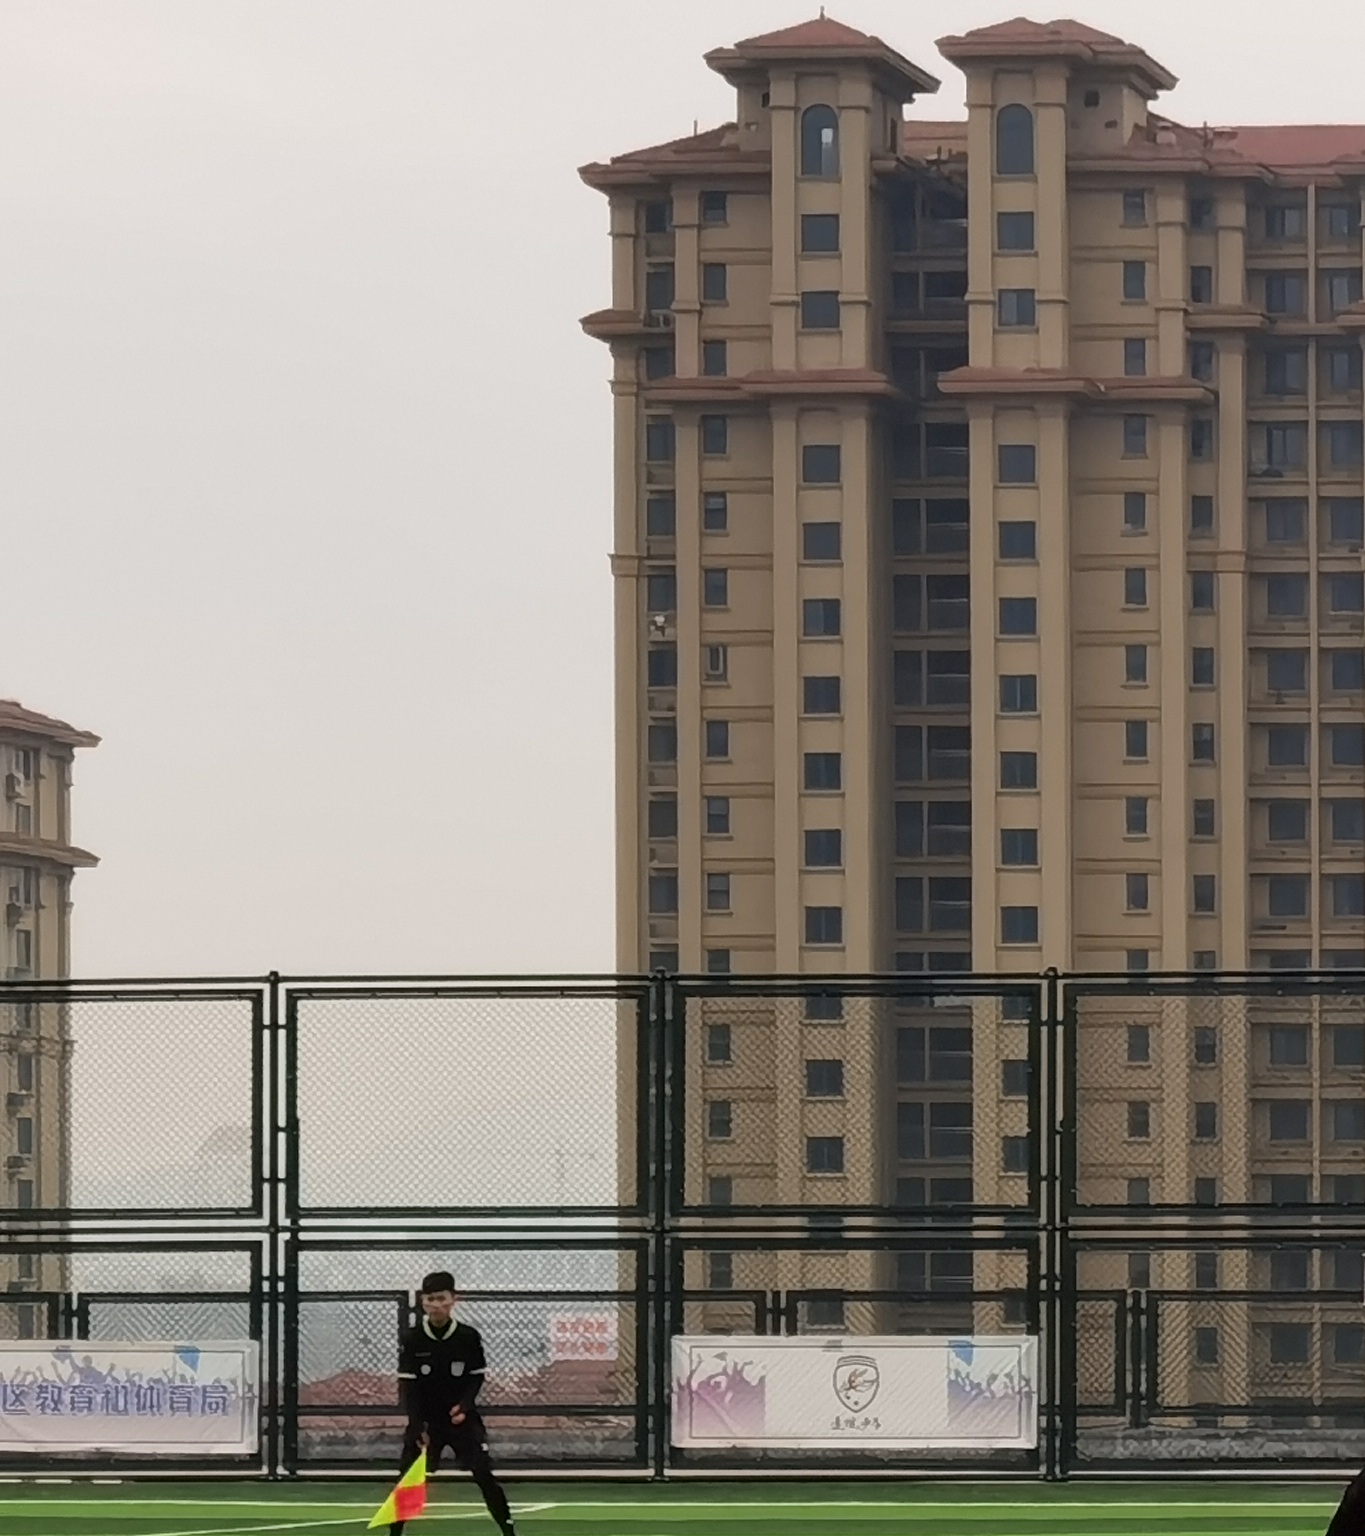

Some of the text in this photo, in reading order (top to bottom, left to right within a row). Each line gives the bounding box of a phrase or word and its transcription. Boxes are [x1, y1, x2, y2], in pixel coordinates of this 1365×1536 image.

[1, 1384, 229, 1417] 区教育和体育局
